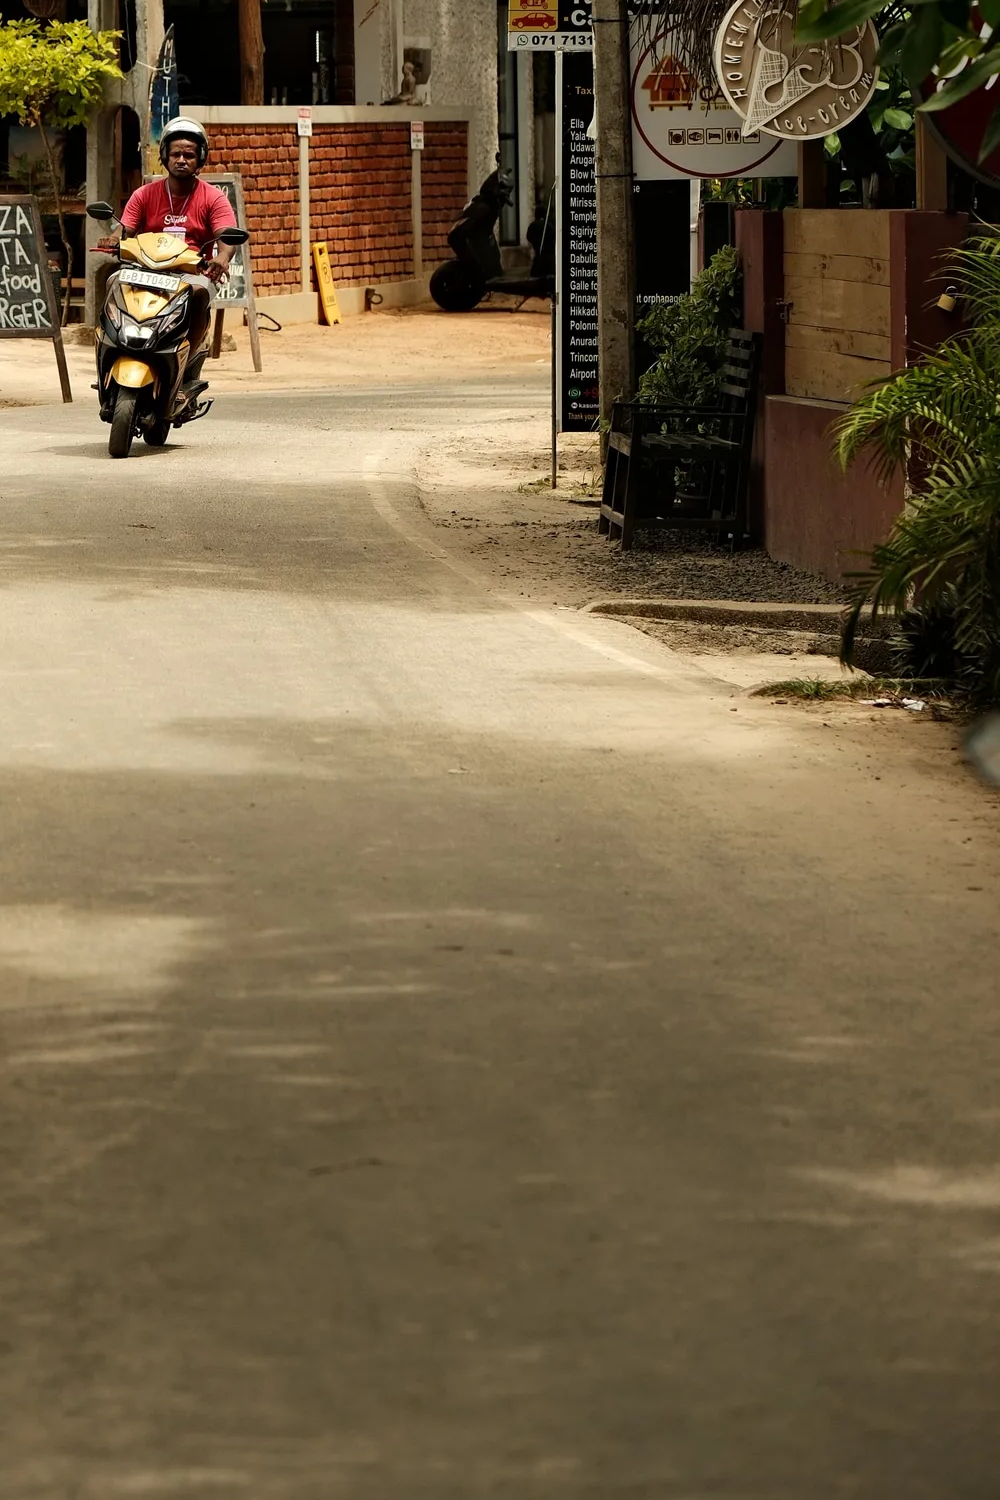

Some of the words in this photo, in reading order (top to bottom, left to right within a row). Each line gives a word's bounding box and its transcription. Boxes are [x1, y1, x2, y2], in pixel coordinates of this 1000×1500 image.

[532, 35, 556, 45] 071
[570, 118, 585, 129] Ella
[570, 130, 586, 141] Yala
[570, 169, 589, 179] Blow
[570, 197, 597, 208] Mirissa
[570, 211, 597, 223] Temple
[570, 280, 589, 291] Galle
[570, 368, 597, 381] Airport
